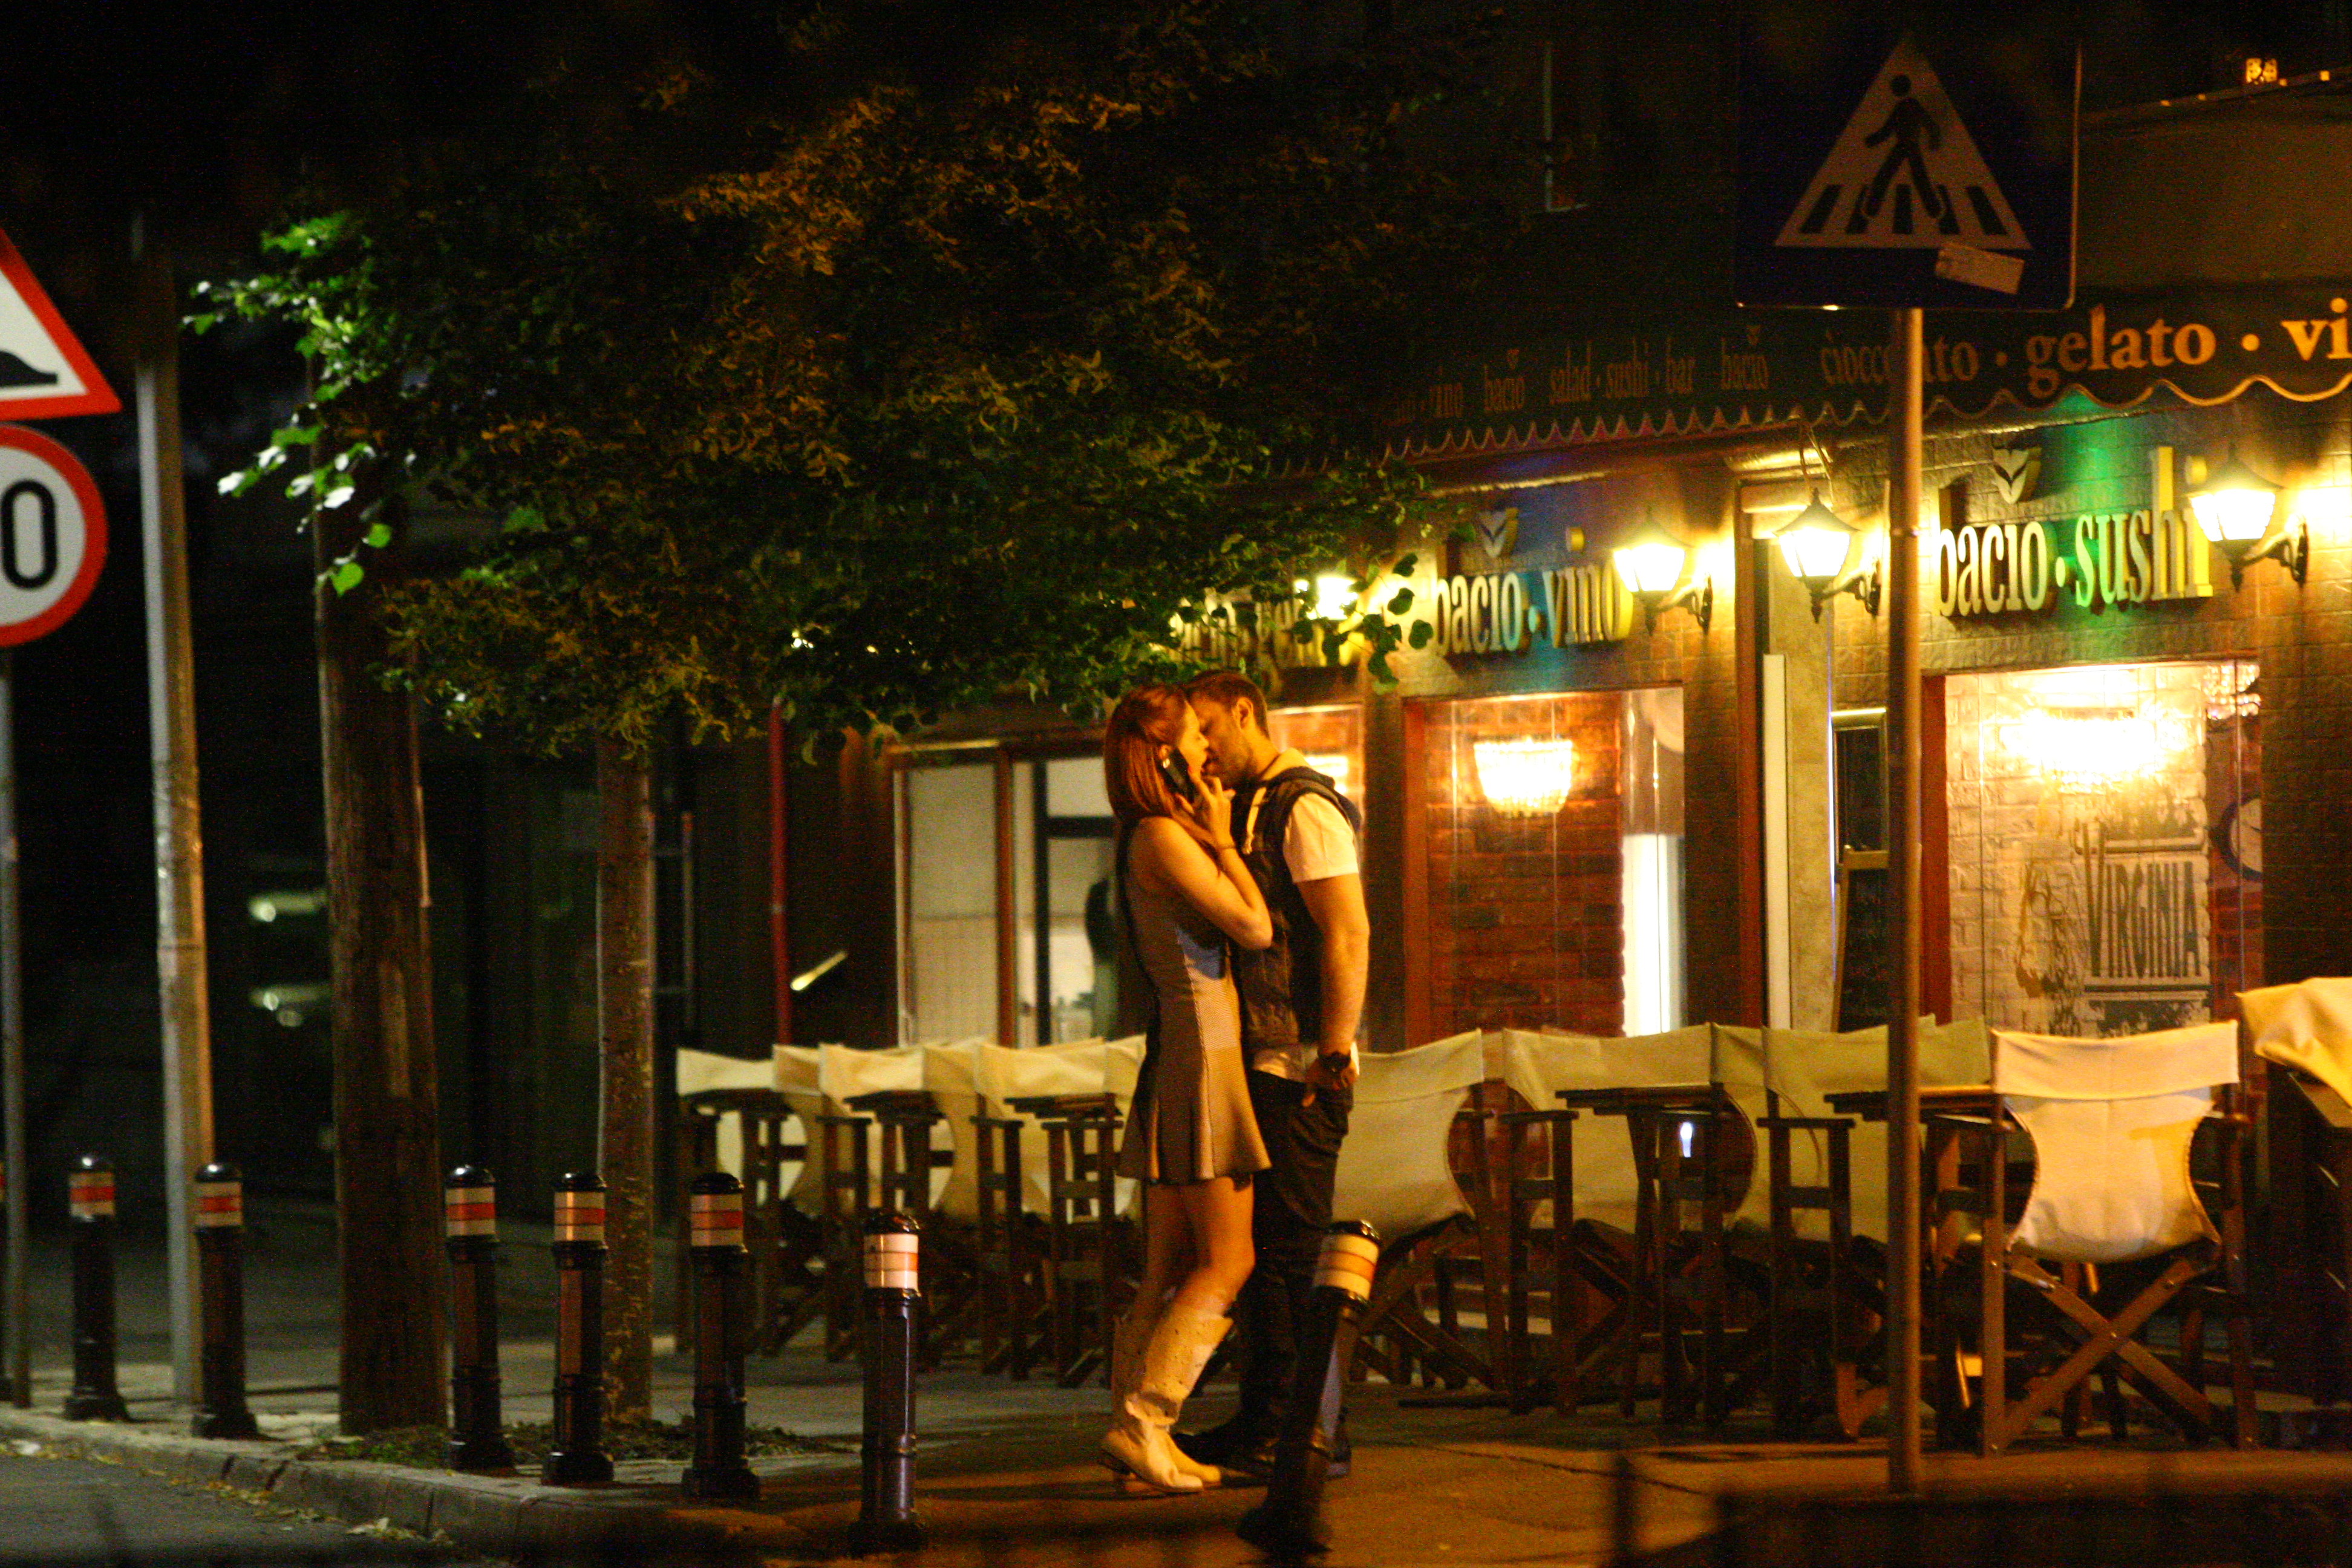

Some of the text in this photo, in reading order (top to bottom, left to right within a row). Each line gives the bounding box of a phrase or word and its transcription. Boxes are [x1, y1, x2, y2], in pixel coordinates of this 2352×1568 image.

[1483, 364, 1524, 411] bacio
[1549, 340, 1590, 404] salad
[1604, 337, 1649, 399] sushi
[1664, 337, 1696, 394] bar
[1720, 337, 1769, 390] bacio
[2026, 304, 2217, 399] gelato
[1543, 526, 1633, 648] vino
[1938, 446, 2213, 617] bacio sushi
